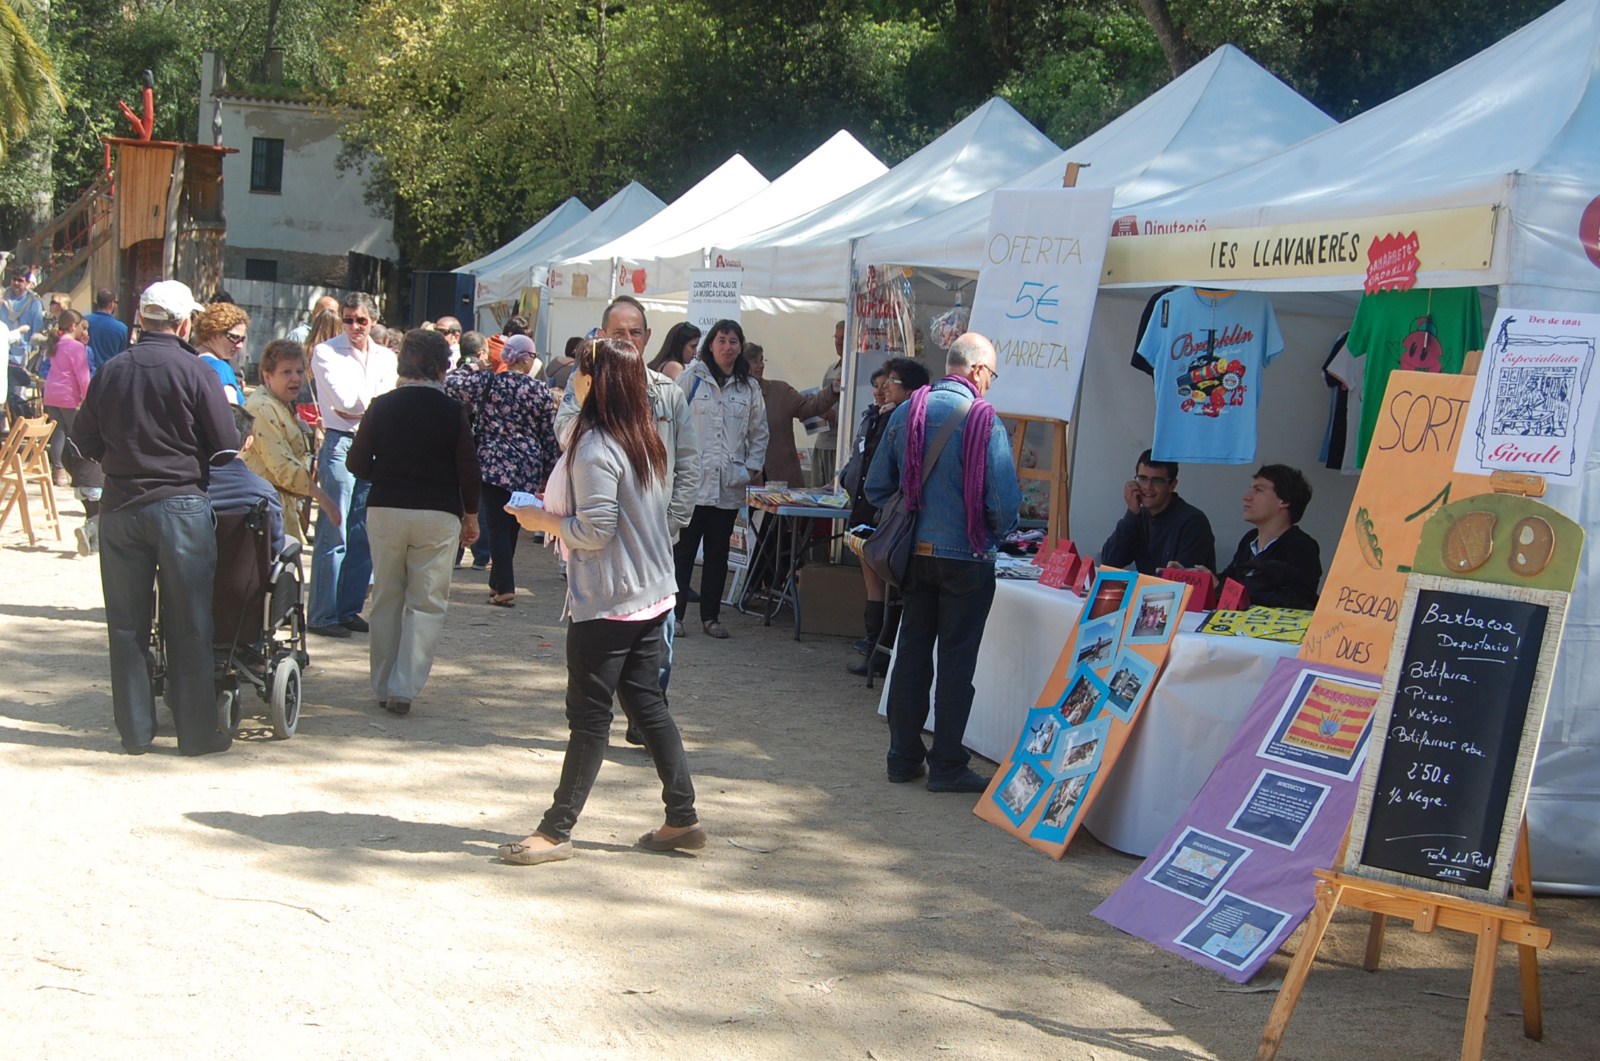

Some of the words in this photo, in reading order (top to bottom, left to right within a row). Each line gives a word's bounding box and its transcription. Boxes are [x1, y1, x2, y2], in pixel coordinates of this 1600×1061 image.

[988, 233, 1082, 264] OFERTA
[1210, 241, 1239, 268] IES
[1253, 231, 1360, 268] LLAVANERES
[1006, 280, 1059, 325] 5€
[1528, 315, 1546, 324] Des
[1547, 317, 1559, 325] de
[990, 338, 1069, 371] MARRETA
[1501, 353, 1580, 366] Especialitats
[1488, 442, 1562, 464] Giralt
[1336, 586, 1398, 622] PESOLAD
[1421, 603, 1516, 634] Barbacoa
[1335, 636, 1373, 663] DUES
